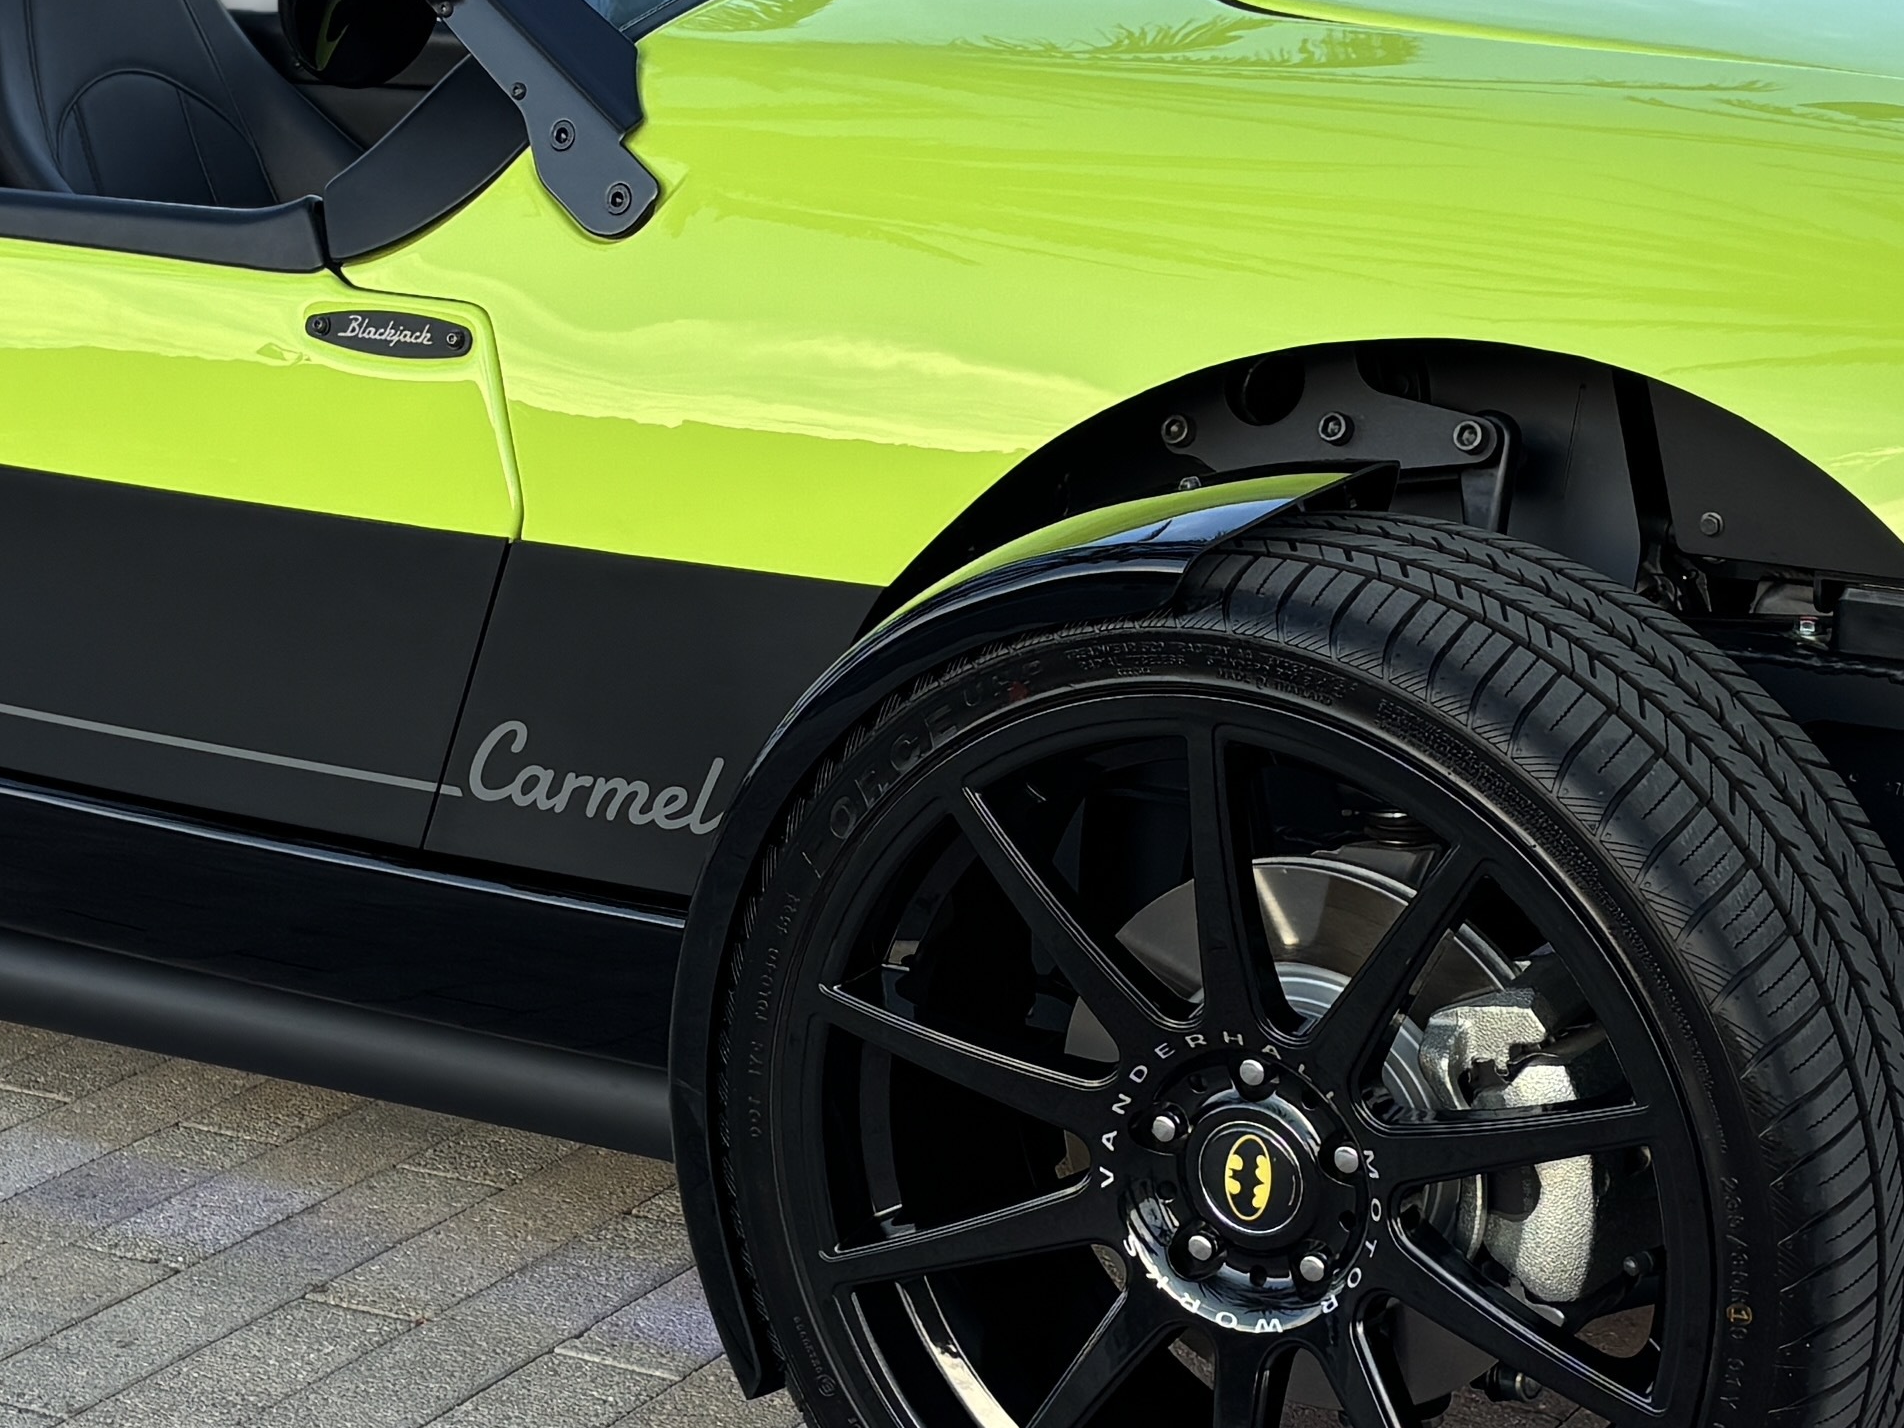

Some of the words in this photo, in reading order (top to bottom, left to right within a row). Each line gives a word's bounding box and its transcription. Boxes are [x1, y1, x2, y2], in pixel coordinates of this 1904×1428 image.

[338, 315, 433, 347] Blackjack
[468, 719, 725, 834] Carmel
[1098, 1031, 1343, 1188] VANDERHALL
[1122, 1234, 1284, 1334] WORKS
[1320, 1149, 1383, 1314] MOTOR
